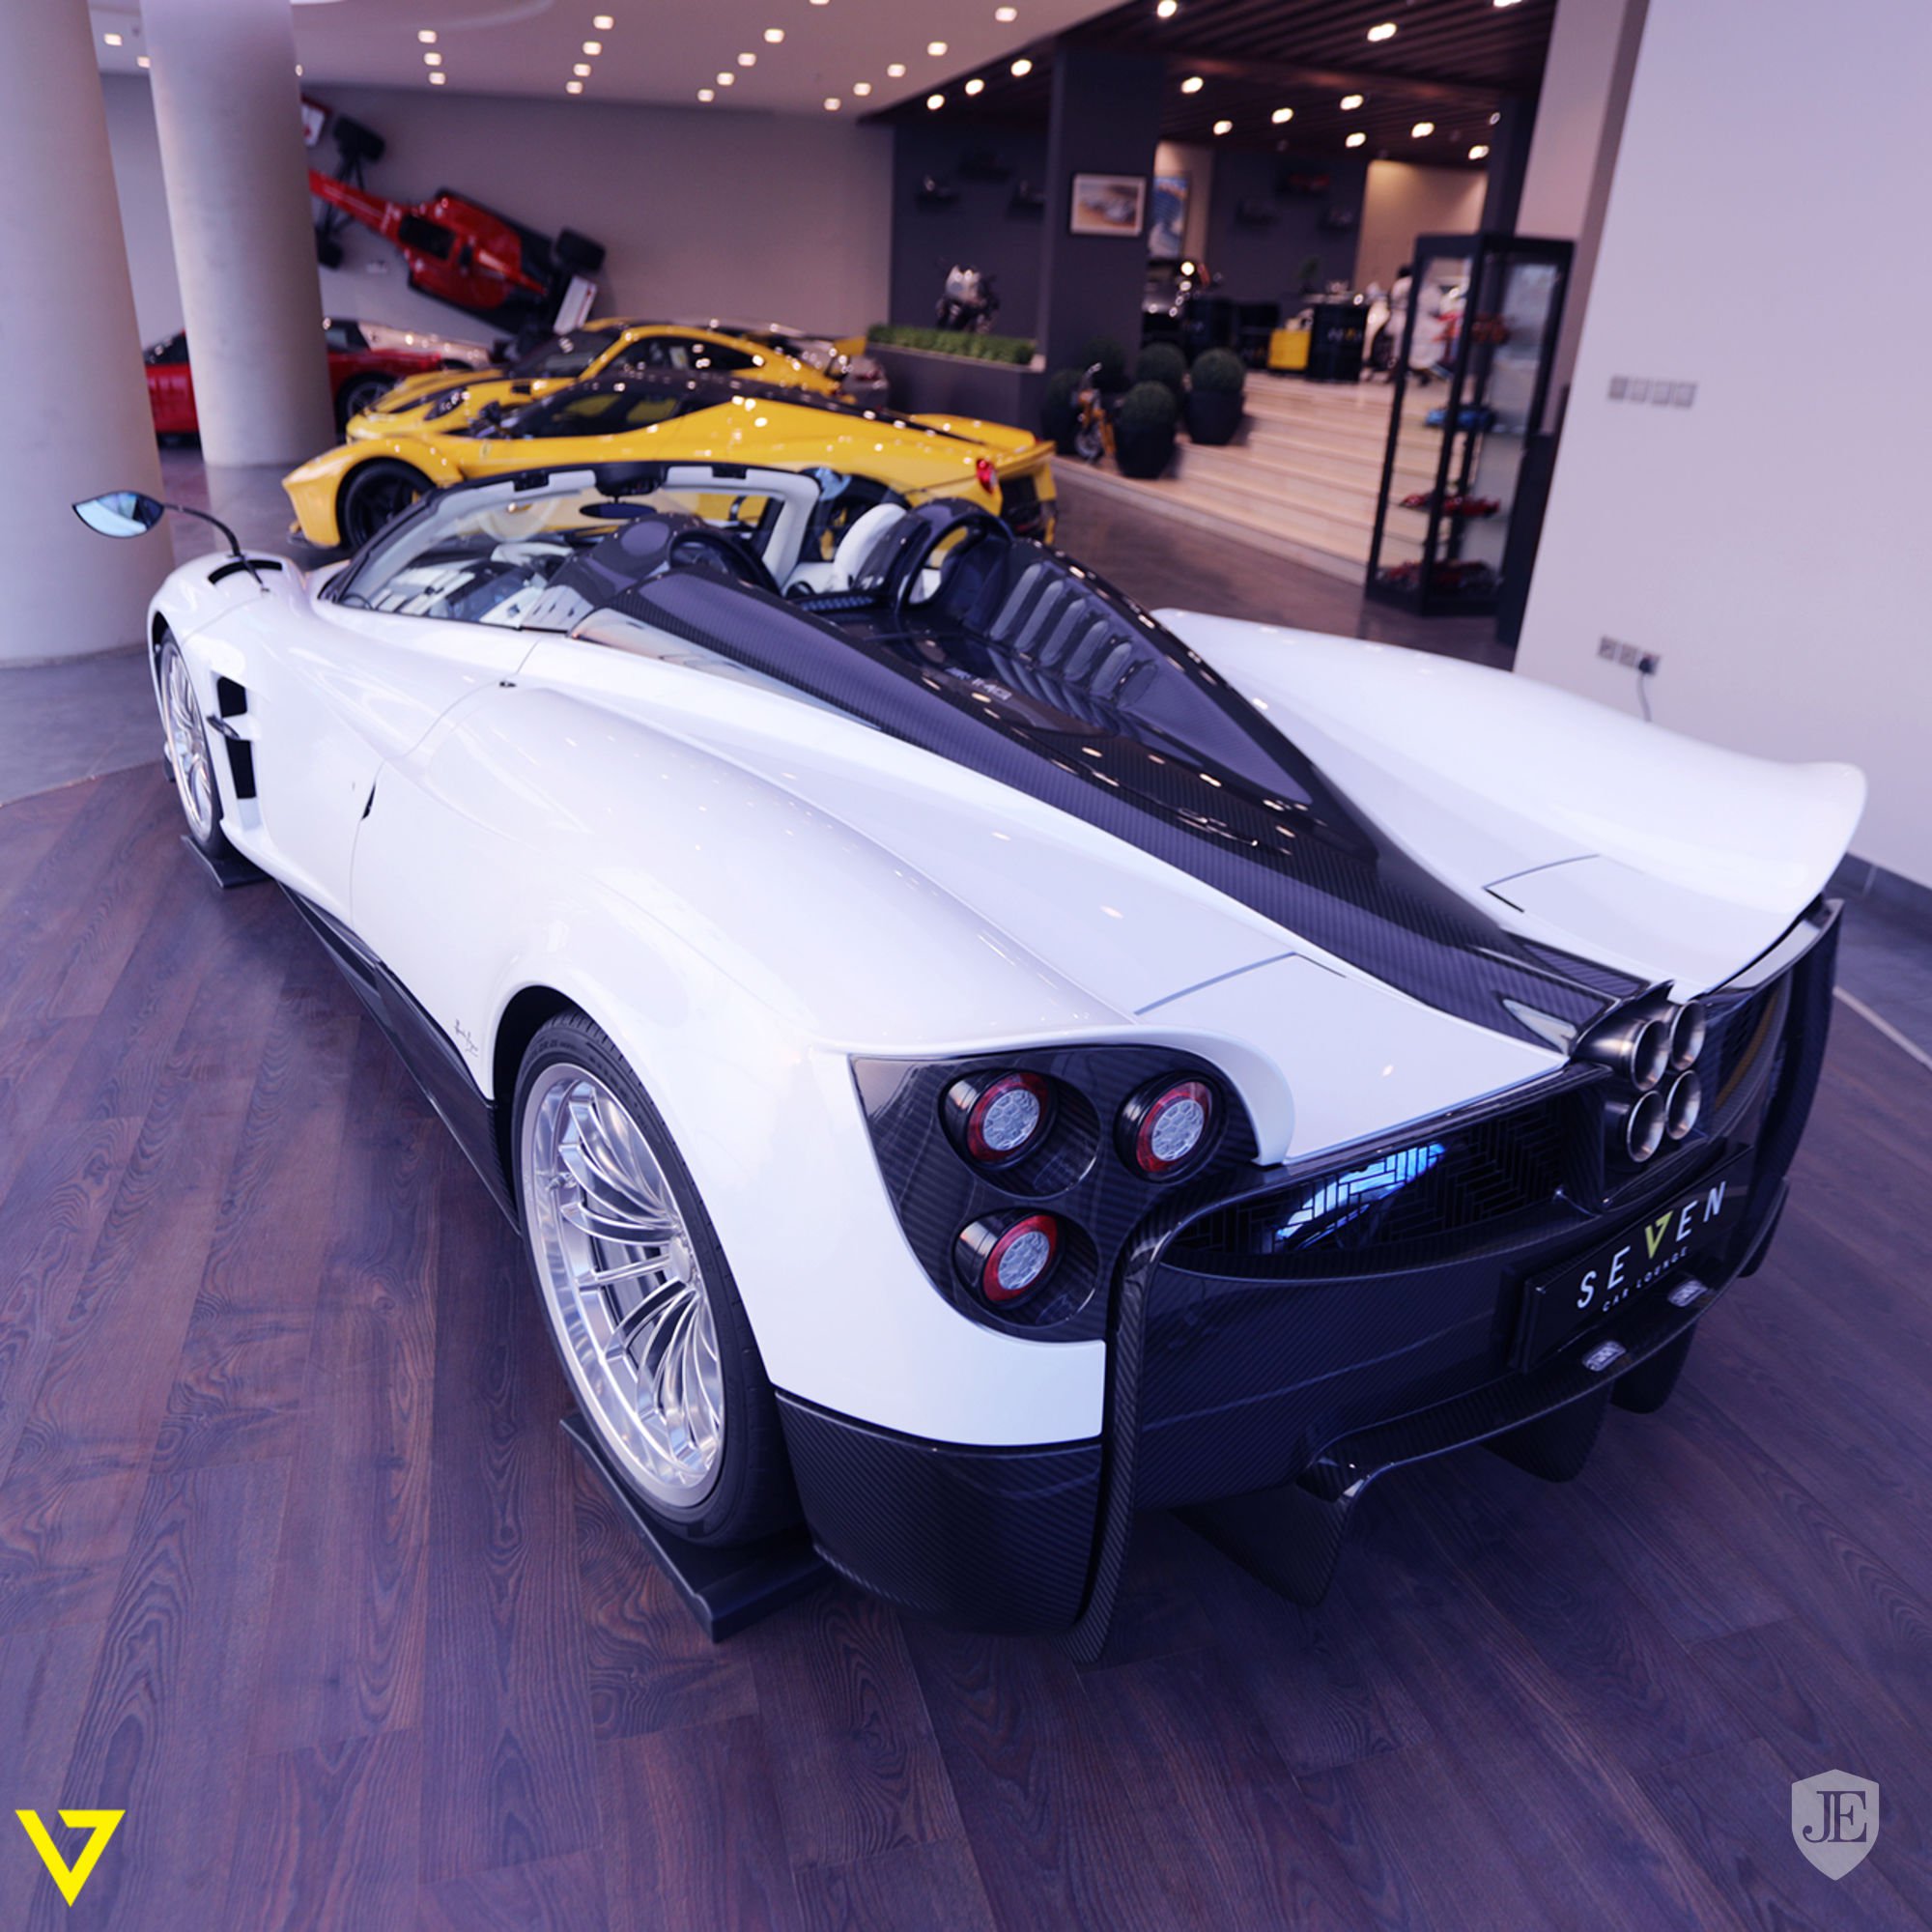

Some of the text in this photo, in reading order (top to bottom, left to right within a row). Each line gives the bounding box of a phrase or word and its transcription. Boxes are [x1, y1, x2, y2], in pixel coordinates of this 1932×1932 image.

[1577, 1180, 1726, 1309] SEVEN
[1603, 1246, 1688, 1312] CAR LOUNGE
